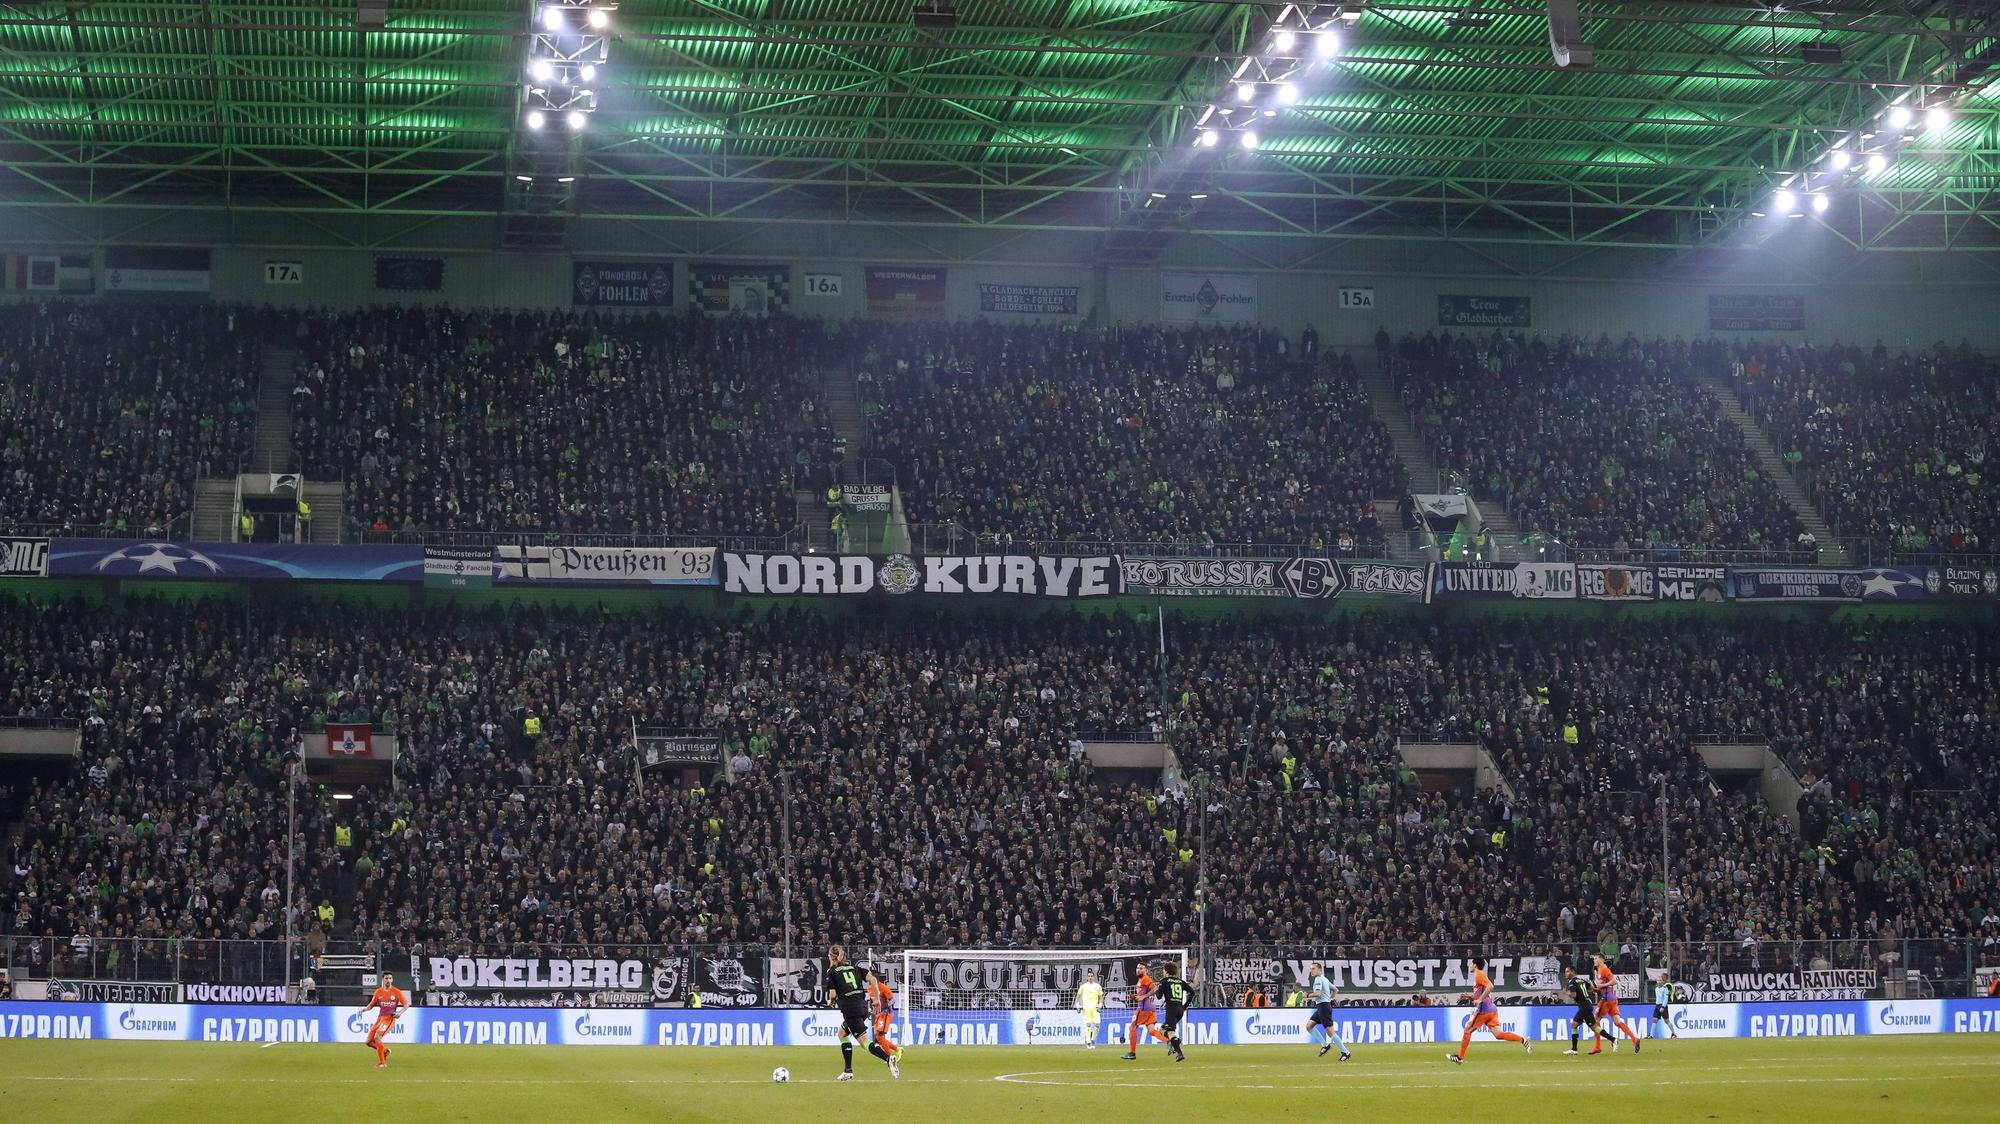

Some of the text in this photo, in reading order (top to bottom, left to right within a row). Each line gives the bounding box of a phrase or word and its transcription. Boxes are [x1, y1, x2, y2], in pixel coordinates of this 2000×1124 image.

[267, 266, 299, 281] 17A
[599, 286, 648, 301] FOHLEN
[807, 278, 839, 293] 16A
[1165, 292, 1254, 305] Enztal Fohlen
[1341, 291, 1371, 306] 15A
[843, 485, 887, 494] BAD VILBEL
[425, 547, 491, 558] Westmünsterland
[425, 562, 491, 572] Gladbach Fanclub
[552, 547, 666, 576] Preußen
[723, 553, 874, 594] NORD
[924, 555, 1111, 597] KURVE
[1122, 559, 1275, 587] BORUSSIA
[1348, 566, 1425, 593] FANS
[1445, 568, 1517, 592] UNITED
[1544, 569, 1573, 592] MG
[1759, 573, 1840, 585] ODENKIRCHNER
[1626, 570, 1654, 595] MG
[1658, 580, 1696, 600] MG
[1782, 584, 1820, 597] JUNGS
[429, 955, 643, 988] BÖKELBERG
[1215, 958, 1272, 971] BEGLEIT
[842, 971, 858, 989] 4
[1213, 970, 1270, 983] SERVICE
[1286, 959, 1513, 987] VTUSSTAT
[1709, 972, 1801, 990] PUMUCKL
[1803, 970, 1875, 988] RATINGEN
[187, 982, 287, 1003] KÜCKHOVEN
[603, 991, 644, 1003] Viersen
[1170, 983, 1183, 999] 19
[1580, 982, 1590, 998] 11
[701, 992, 734, 1006] BANDA
[136, 1019, 177, 1031] GAZPROM
[1689, 1018, 1726, 1030] GAZPROM
[1751, 1014, 1855, 1037] GAZPROM
[1895, 1015, 1931, 1026] GAZPROM
[203, 1017, 319, 1042] GAZPROM
[431, 1020, 547, 1044] GAZPROM
[591, 1024, 632, 1036] GAZPROM
[659, 1022, 774, 1046] GAZPROM
[1040, 1025, 1082, 1037] GAZPROM
[1261, 1024, 1300, 1036] GAZPROM
